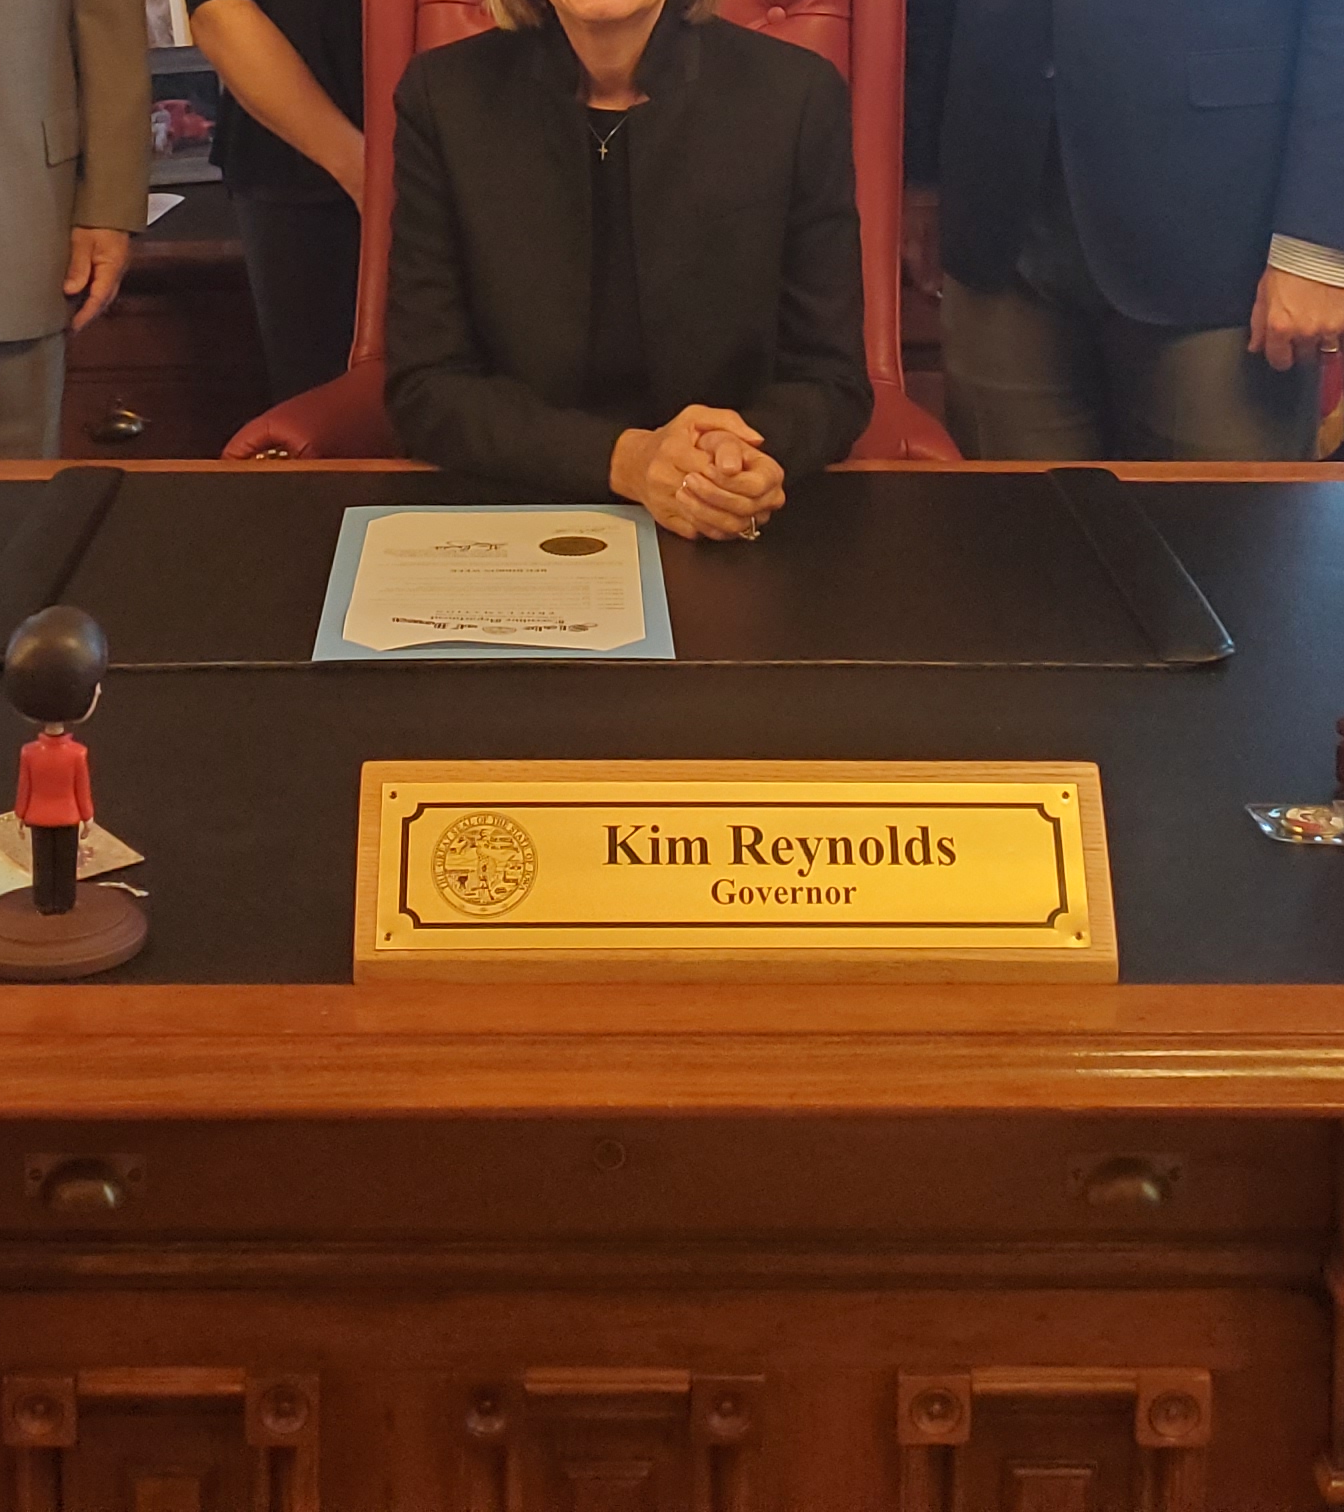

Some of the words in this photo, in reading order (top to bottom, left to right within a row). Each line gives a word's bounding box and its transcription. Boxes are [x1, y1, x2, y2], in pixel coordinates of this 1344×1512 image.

[602, 824, 711, 865] Kim
[726, 824, 957, 877] Reynolds
[711, 879, 857, 904] Governor
